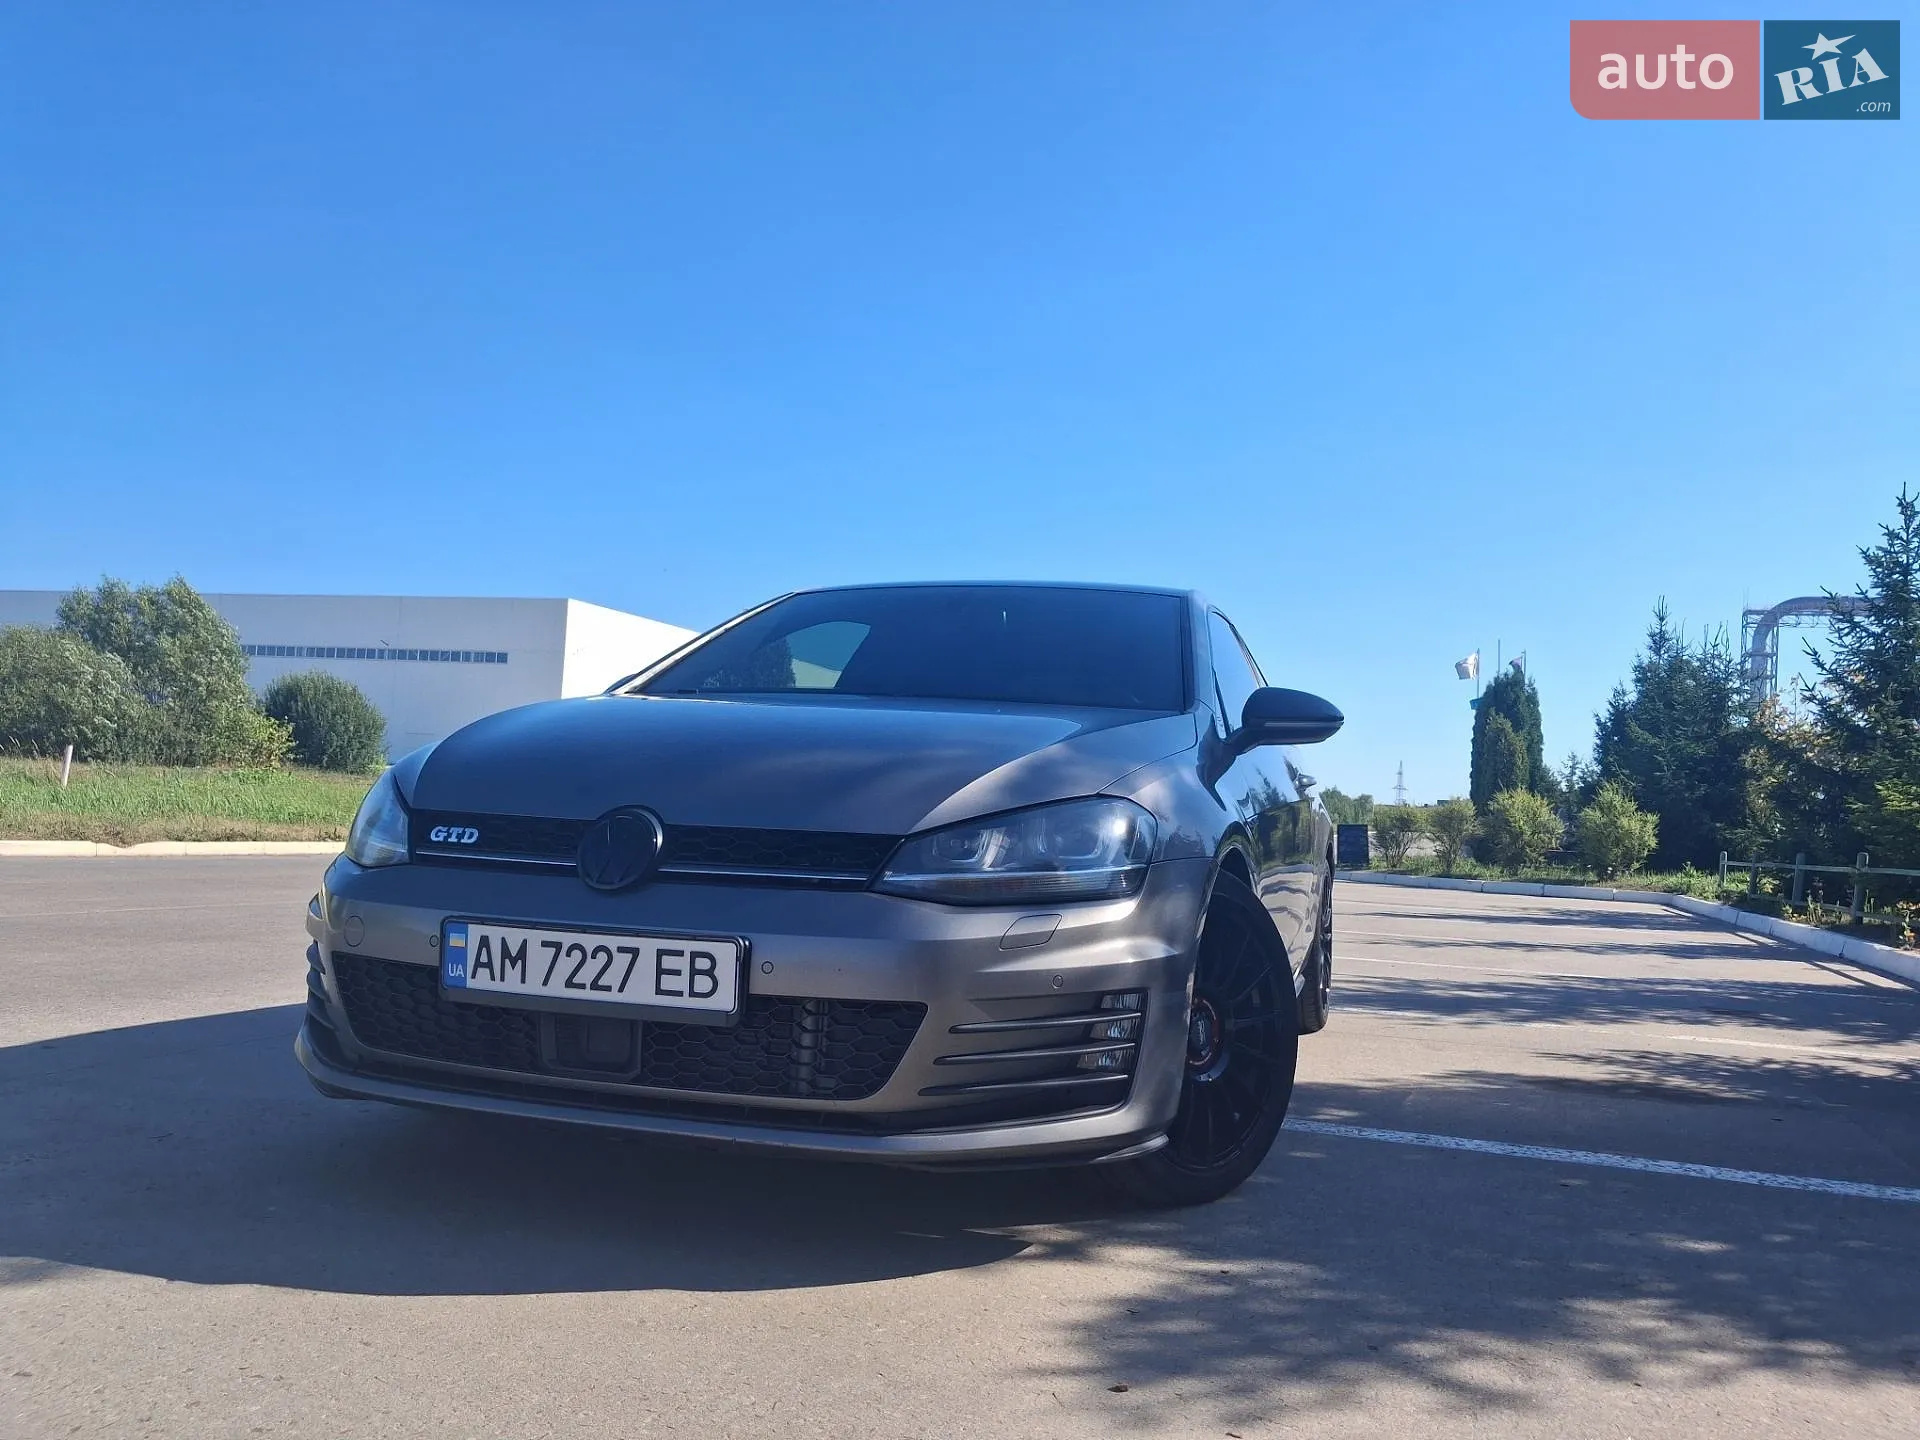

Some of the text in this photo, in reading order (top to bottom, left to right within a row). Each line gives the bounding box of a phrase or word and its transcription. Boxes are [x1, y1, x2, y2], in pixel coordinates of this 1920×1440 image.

[430, 826, 479, 844] GTD
[448, 963, 465, 978] UA
[470, 935, 719, 999] AM 7227 EB
